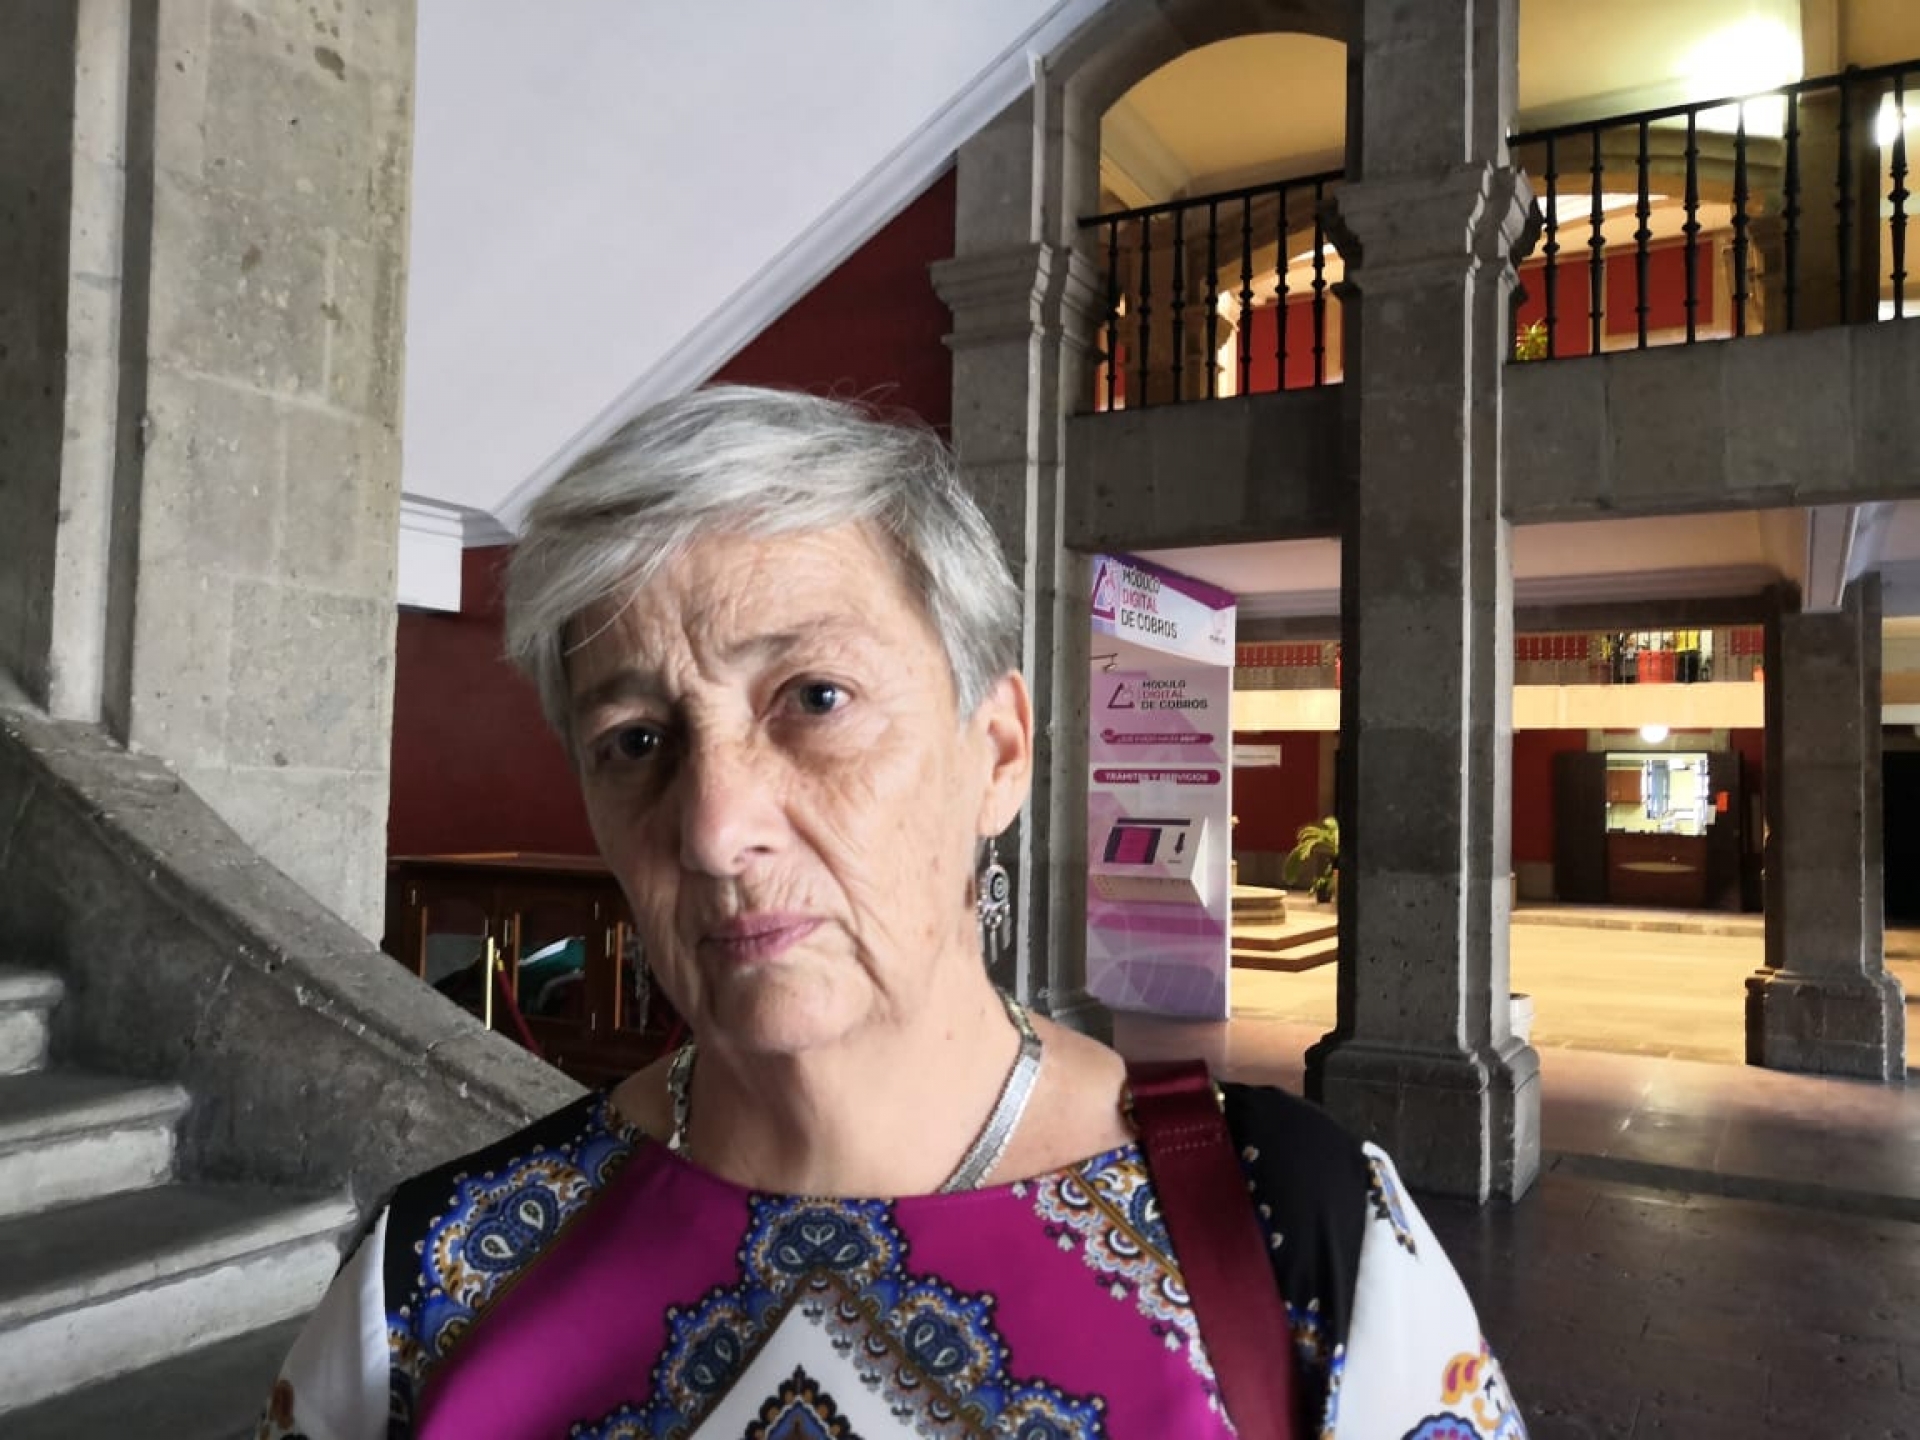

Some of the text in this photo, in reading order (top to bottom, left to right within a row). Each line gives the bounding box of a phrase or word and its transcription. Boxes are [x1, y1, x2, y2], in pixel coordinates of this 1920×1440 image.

[1122, 589, 1159, 614] DIGITAL
[1121, 607, 1178, 639] DE COBROS
[1143, 689, 1185, 699] DIGITAL
[1141, 698, 1208, 709] DE COBROS
